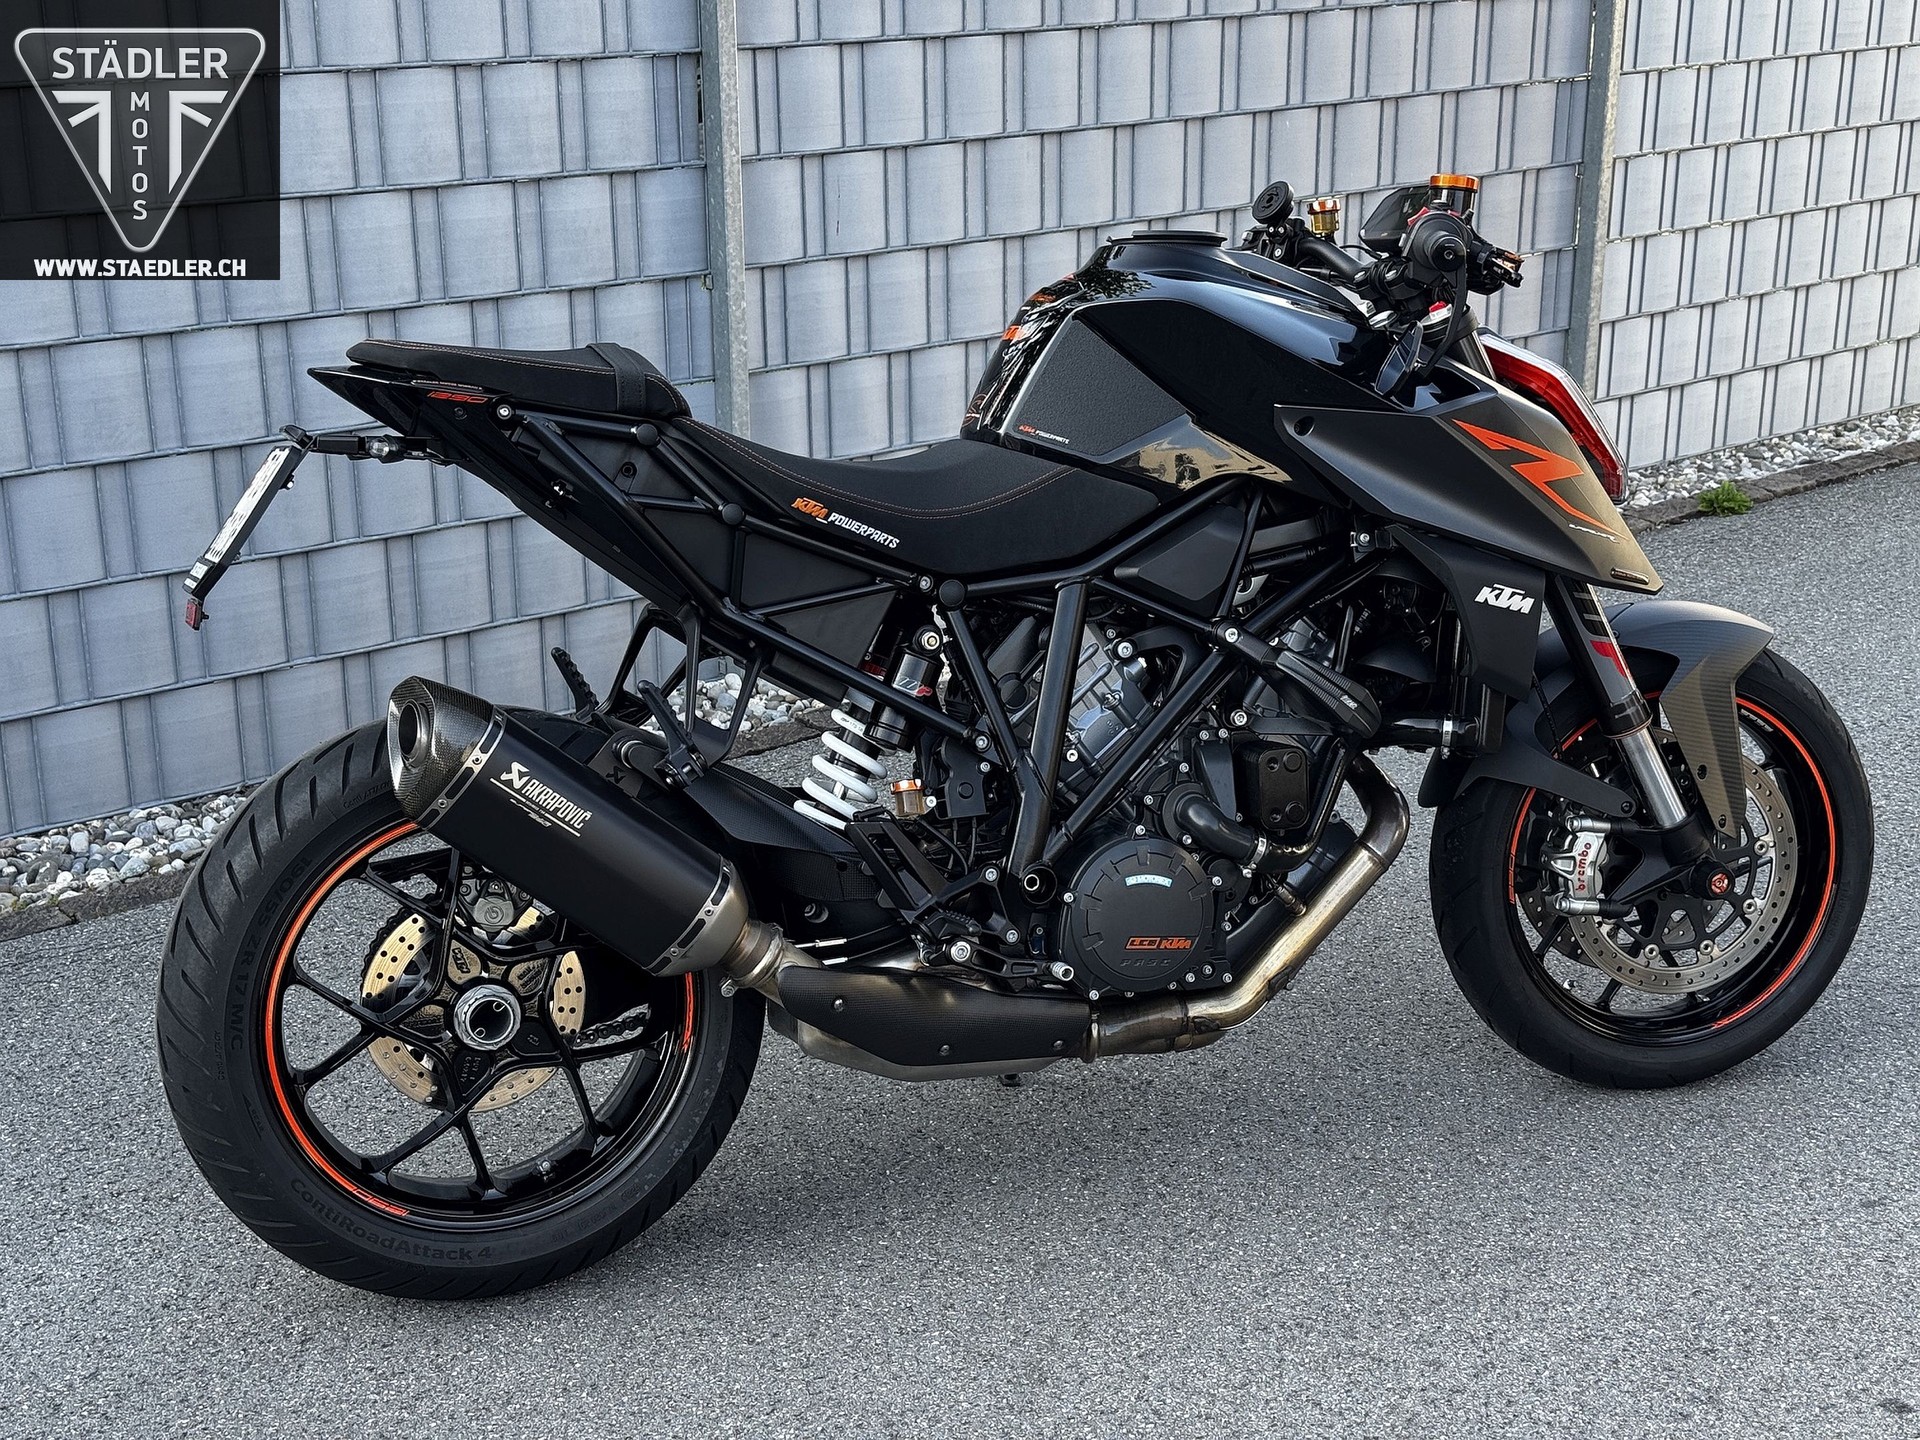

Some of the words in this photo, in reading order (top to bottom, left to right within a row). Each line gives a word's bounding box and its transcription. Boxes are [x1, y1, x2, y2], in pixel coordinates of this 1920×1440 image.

[827, 512, 900, 549] POWERPARTS
[1474, 583, 1536, 615] KTM
[1575, 842, 1592, 891] brembo
[1159, 937, 1192, 949] KTM
